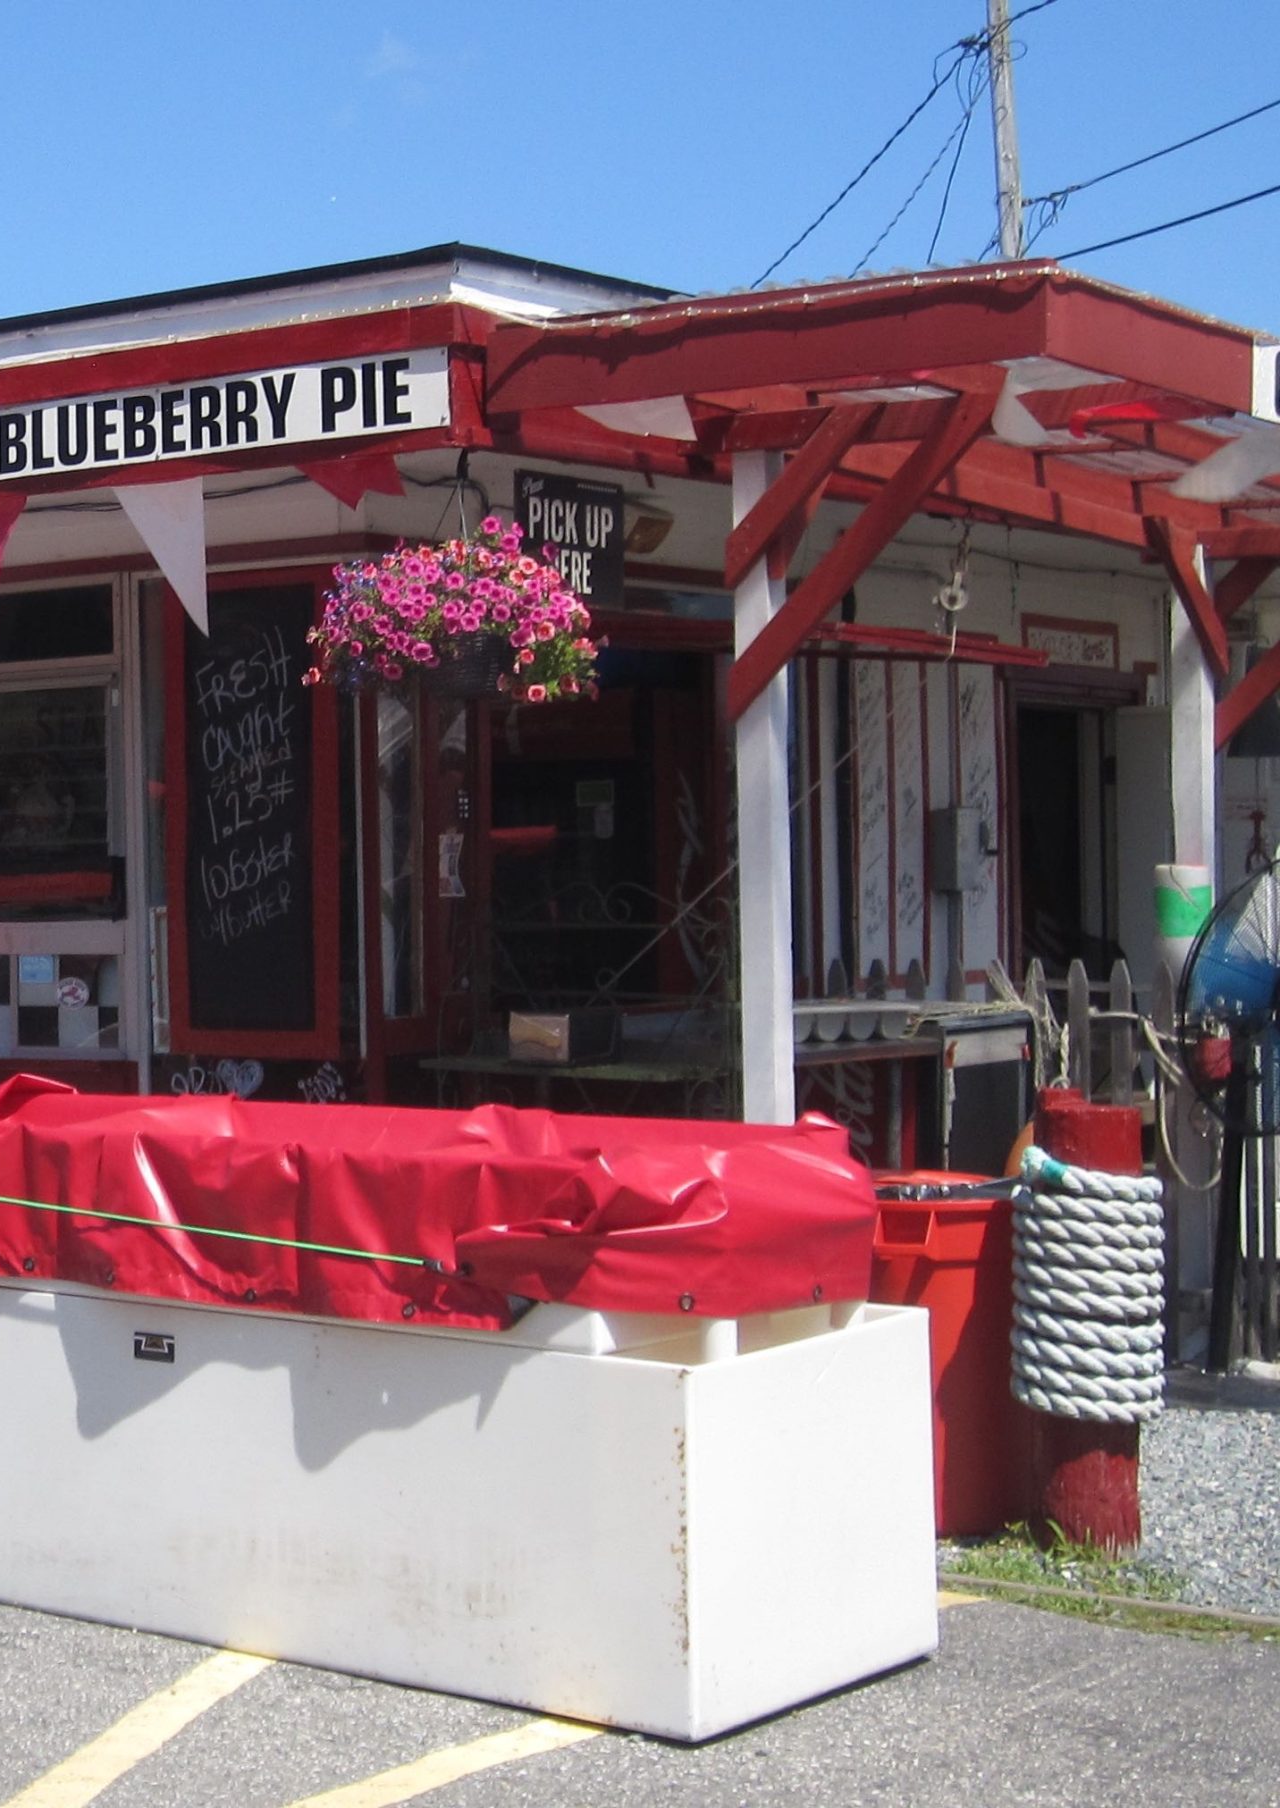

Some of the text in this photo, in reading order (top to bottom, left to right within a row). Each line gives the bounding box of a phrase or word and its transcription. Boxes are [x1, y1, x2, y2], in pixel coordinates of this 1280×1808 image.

[321, 358, 413, 433] PIE
[529, 497, 613, 548] PICK UP
[554, 549, 592, 595] ERE
[195, 625, 292, 717] FRESH
